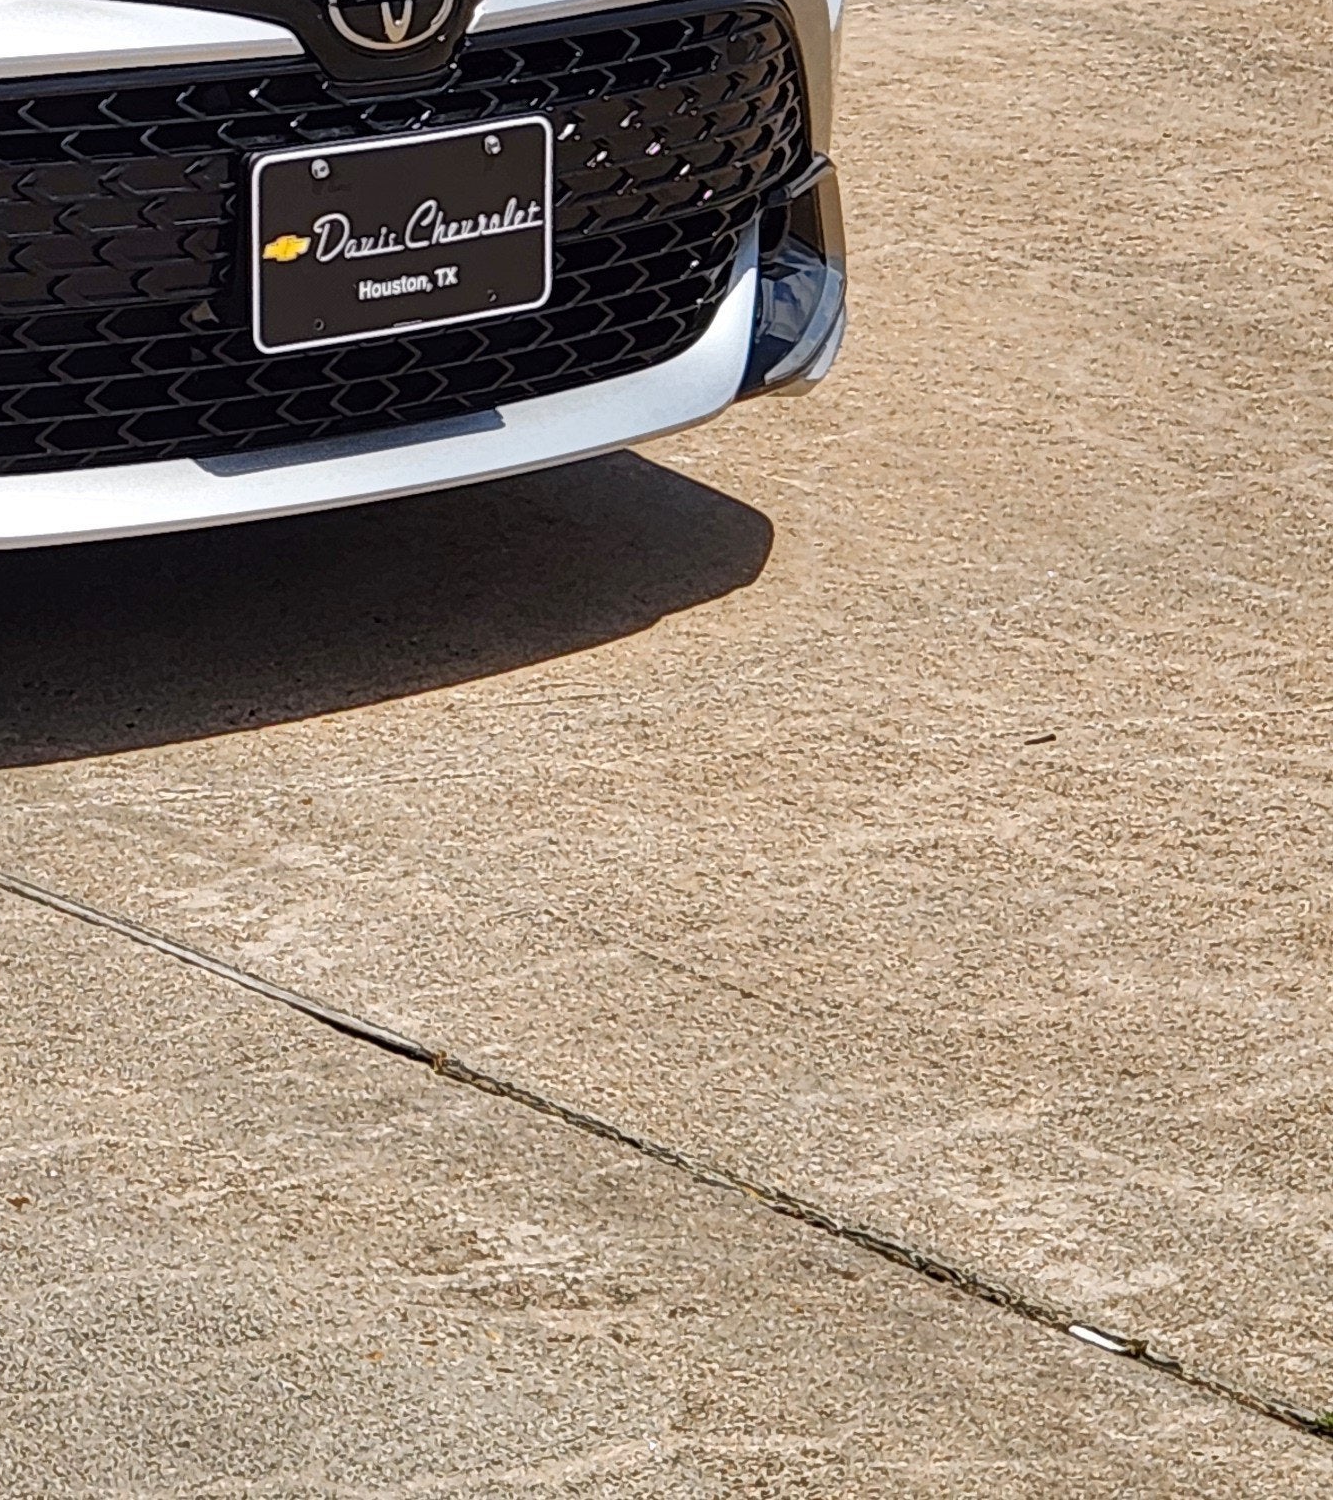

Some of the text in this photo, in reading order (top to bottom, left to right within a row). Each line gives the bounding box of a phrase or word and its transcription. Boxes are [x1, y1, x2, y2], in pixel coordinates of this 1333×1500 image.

[313, 196, 544, 263] Davis Chevrolet
[358, 265, 459, 301] Houston, TX
